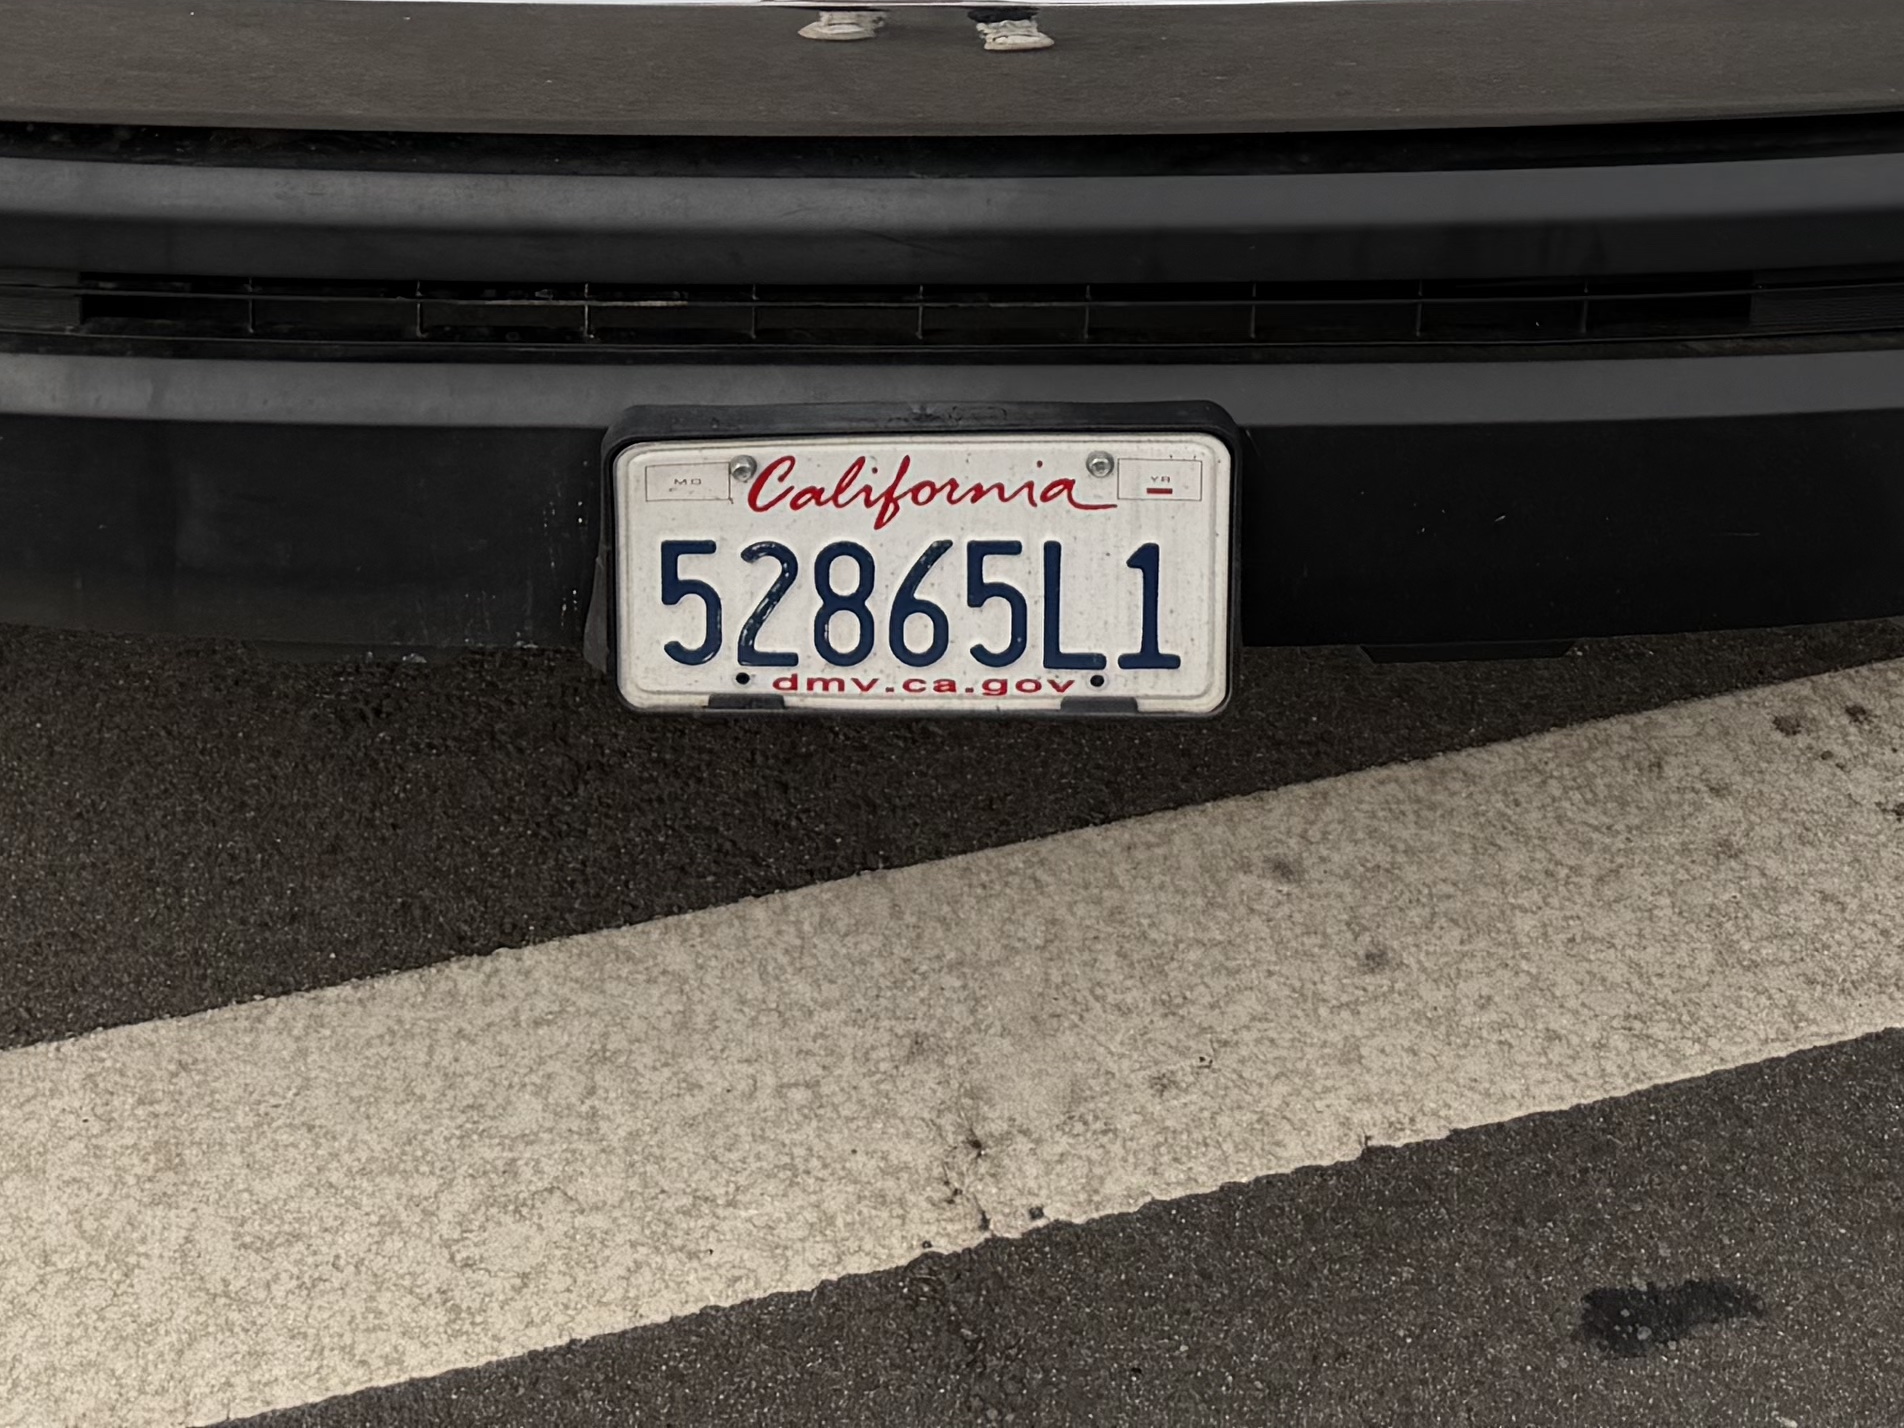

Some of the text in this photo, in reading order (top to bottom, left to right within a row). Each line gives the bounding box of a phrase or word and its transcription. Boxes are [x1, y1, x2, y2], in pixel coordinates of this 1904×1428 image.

[673, 477, 703, 486] MO
[747, 455, 1118, 530] California
[660, 539, 1182, 671] 52865L1
[772, 673, 1076, 697] dmv.ca.gov
